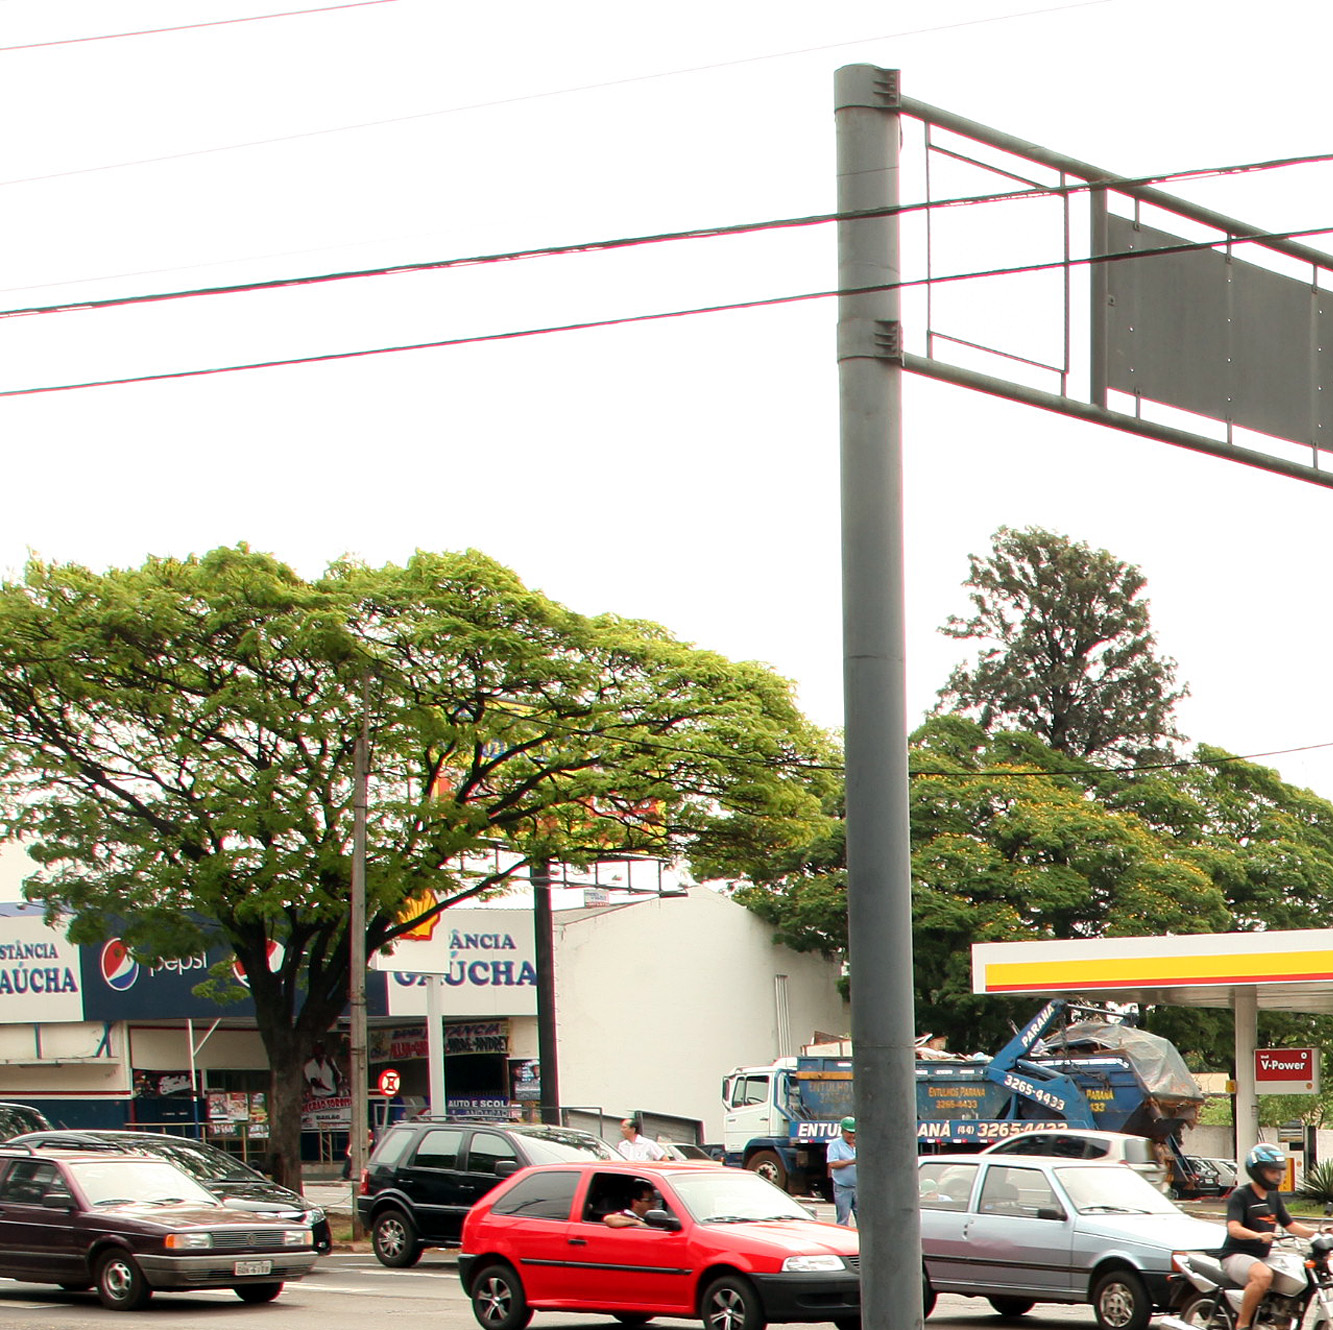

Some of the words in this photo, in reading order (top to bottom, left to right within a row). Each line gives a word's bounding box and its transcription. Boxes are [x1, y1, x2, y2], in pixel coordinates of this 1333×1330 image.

[1260, 1059, 1305, 1070] V-Power
[1004, 1074, 1066, 1111] 3265-4433
[957, 1124, 975, 1135] (44)
